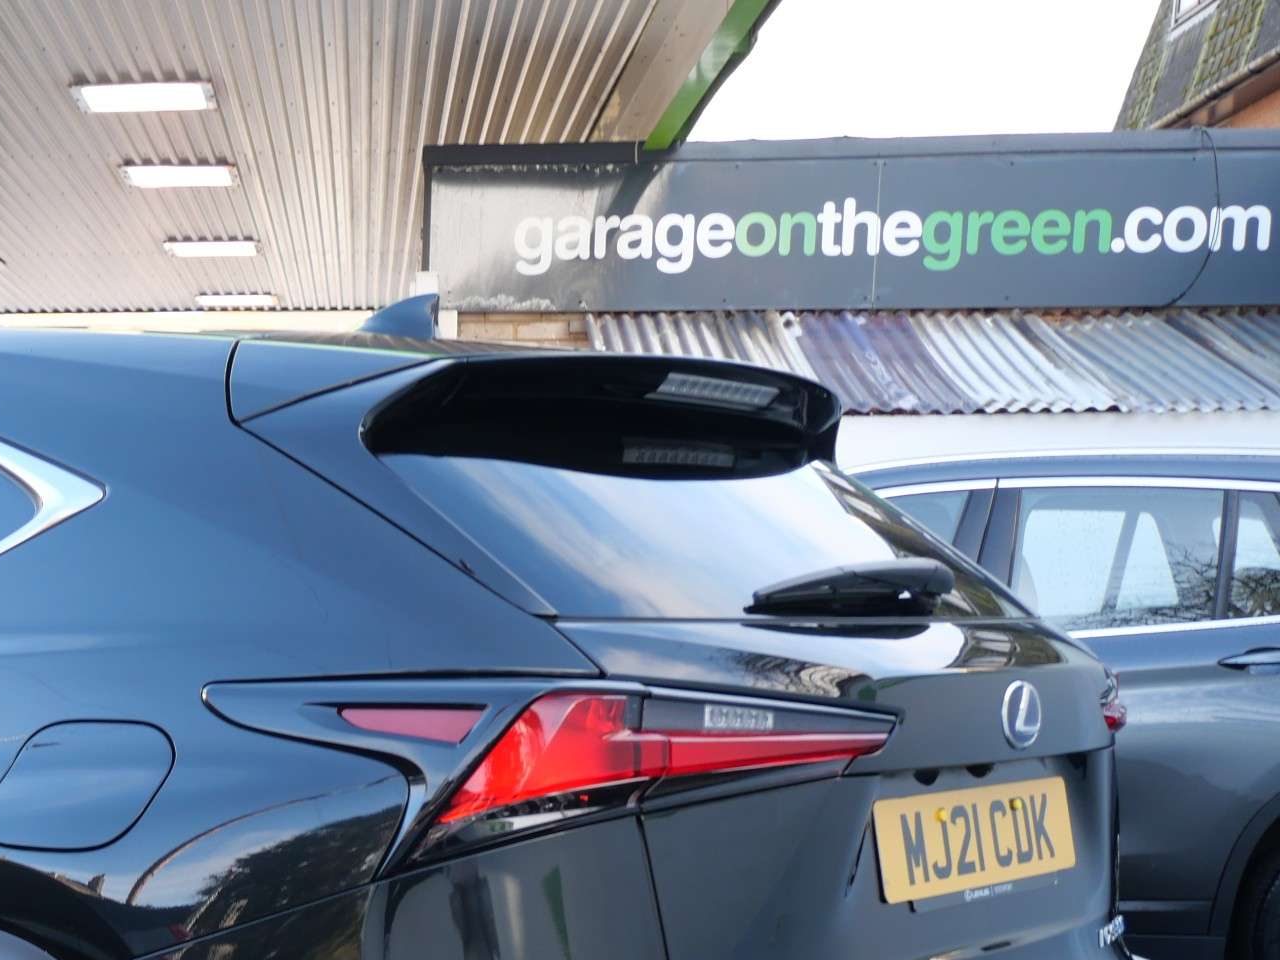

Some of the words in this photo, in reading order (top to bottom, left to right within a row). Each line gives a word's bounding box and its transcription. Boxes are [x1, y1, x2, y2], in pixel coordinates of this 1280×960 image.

[514, 196, 1272, 276] garageonthegreen.com
[900, 802, 986, 886] MJ21
[989, 793, 1056, 868] CDK
